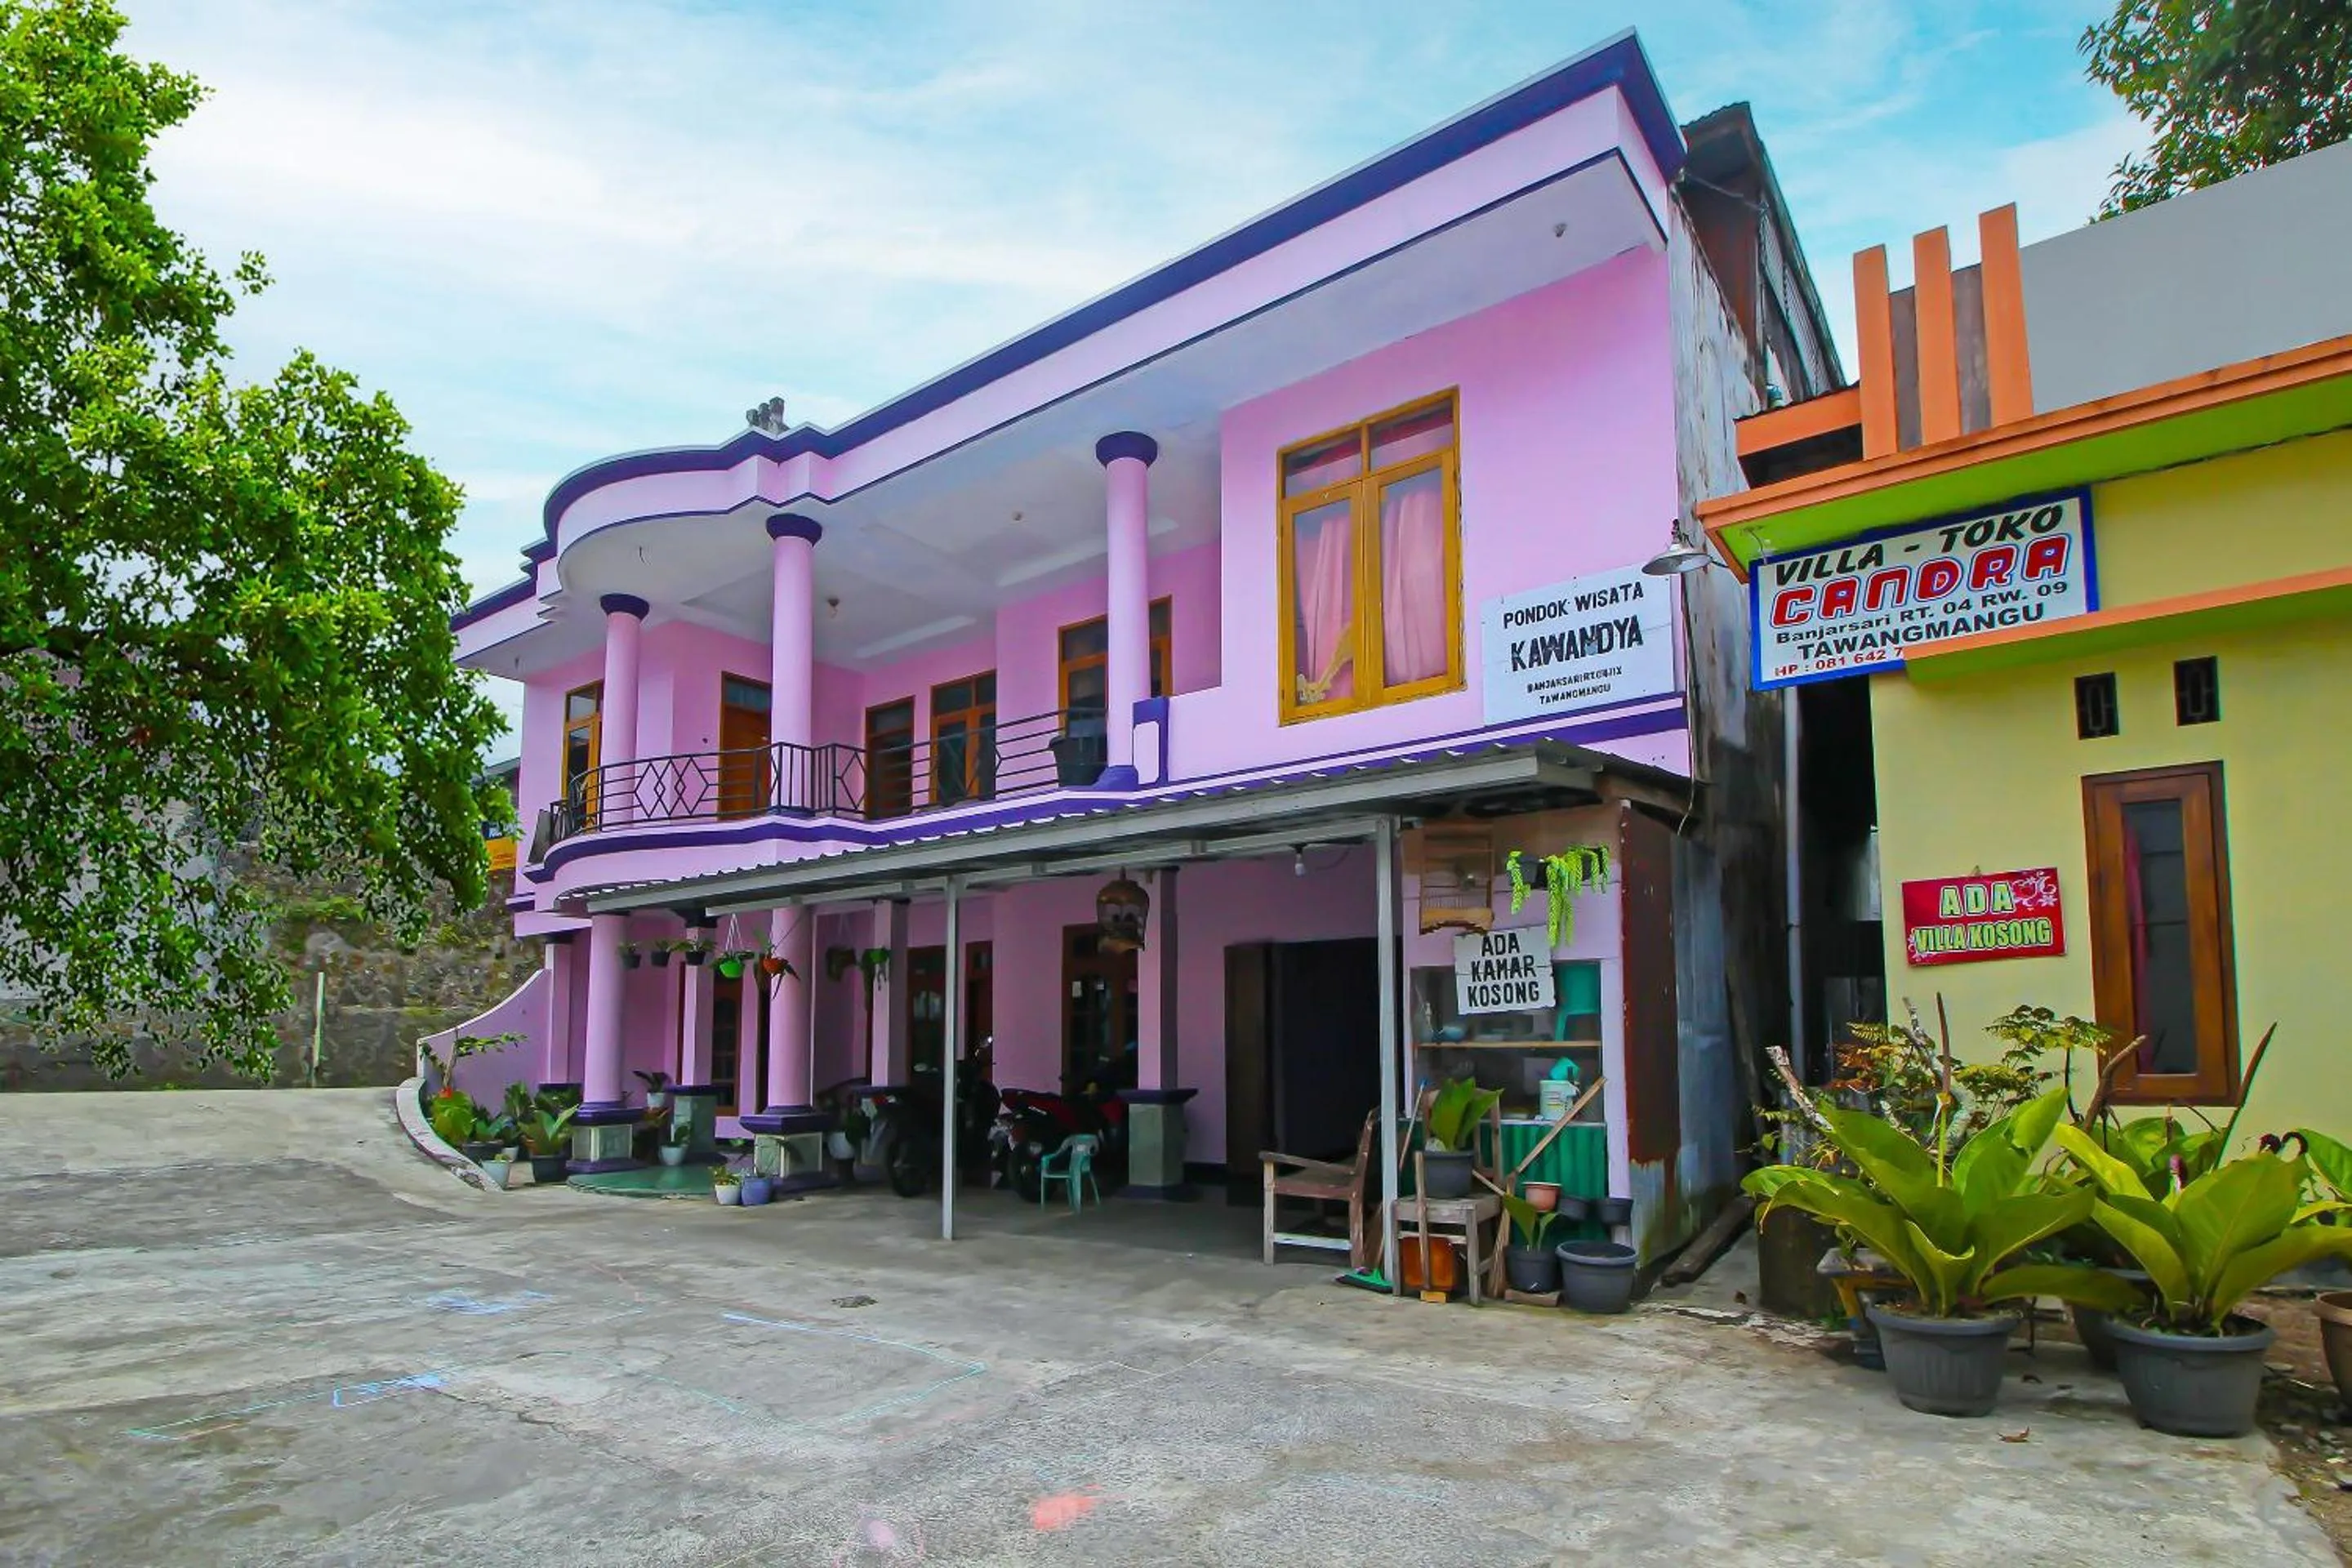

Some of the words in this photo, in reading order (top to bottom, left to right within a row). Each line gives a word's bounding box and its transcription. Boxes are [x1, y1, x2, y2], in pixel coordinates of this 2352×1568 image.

[1775, 544, 1884, 586] VILLA
[1939, 505, 2063, 553] TOKO
[1771, 533, 2071, 628] CANDRA
[1503, 600, 1569, 629] PONDOK
[1575, 581, 1644, 612] WISATA
[1776, 614, 1890, 644] Banjarsari
[1900, 606, 1934, 622] RT.
[1943, 599, 1972, 614] 04
[1981, 590, 2028, 608] RW.
[2037, 581, 2067, 596] 09
[1511, 615, 1643, 671] KAWANDYA
[1797, 603, 2044, 660] TAWANGMANGU
[1775, 664, 1797, 677] HP
[1815, 658, 1845, 670] 081
[1854, 650, 1886, 664] 642
[1940, 881, 2016, 918] ADA
[1481, 933, 1520, 956] ADA
[1913, 924, 1967, 954] VILLA
[1967, 918, 2053, 951] KOSONG
[1471, 955, 1536, 982] KAMAR
[1468, 981, 1539, 1007] KOSONG
